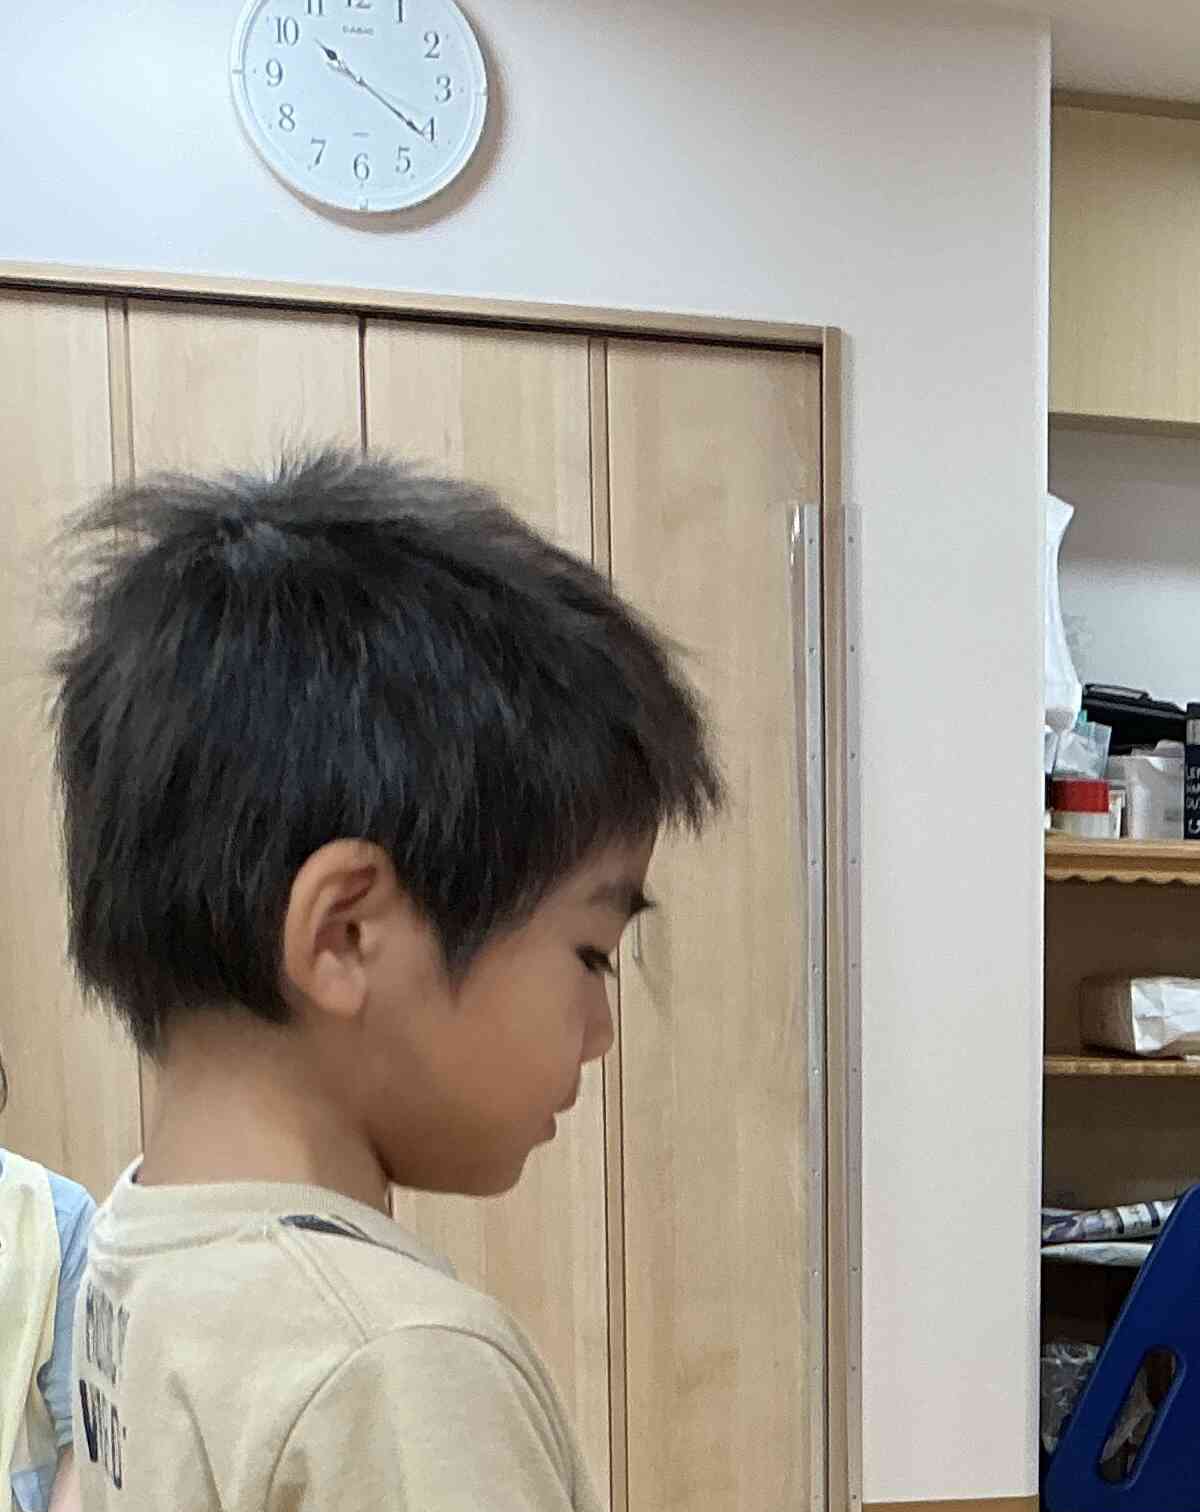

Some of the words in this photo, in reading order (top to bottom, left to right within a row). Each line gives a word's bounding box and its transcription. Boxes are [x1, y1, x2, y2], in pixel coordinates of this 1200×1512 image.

[275, 17, 299, 46] 10
[423, 32, 440, 59] 2
[265, 59, 283, 87] 9
[435, 76, 451, 102] 3
[279, 104, 296, 132] 8
[423, 118, 435, 142] 4
[310, 139, 326, 166] 7
[396, 147, 411, 174] 5
[353, 153, 370, 181] 6
